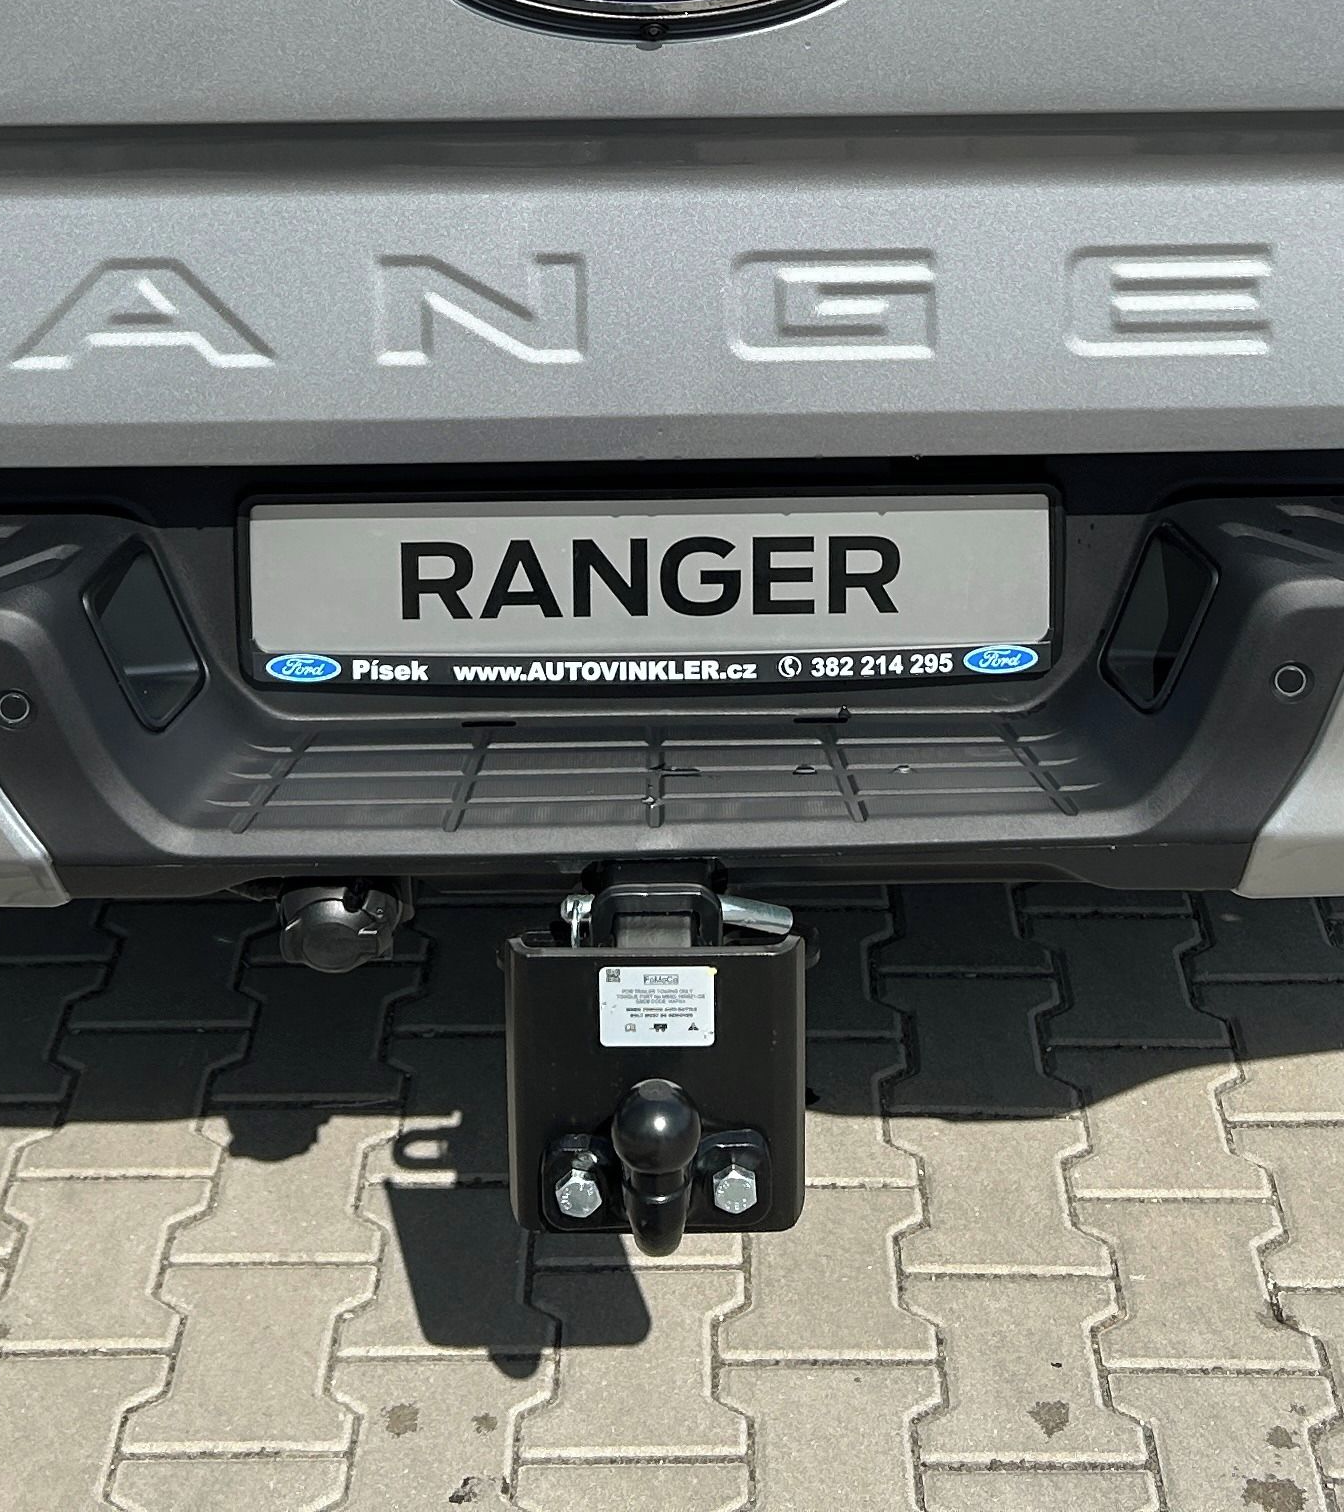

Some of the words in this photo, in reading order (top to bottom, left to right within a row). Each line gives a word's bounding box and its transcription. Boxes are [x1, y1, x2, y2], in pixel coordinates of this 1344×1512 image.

[399, 535, 903, 621] RANGER
[352, 658, 429, 682] Písek
[453, 659, 758, 683] www.AUTOVINKLER.cz
[810, 656, 854, 678] 382
[860, 654, 904, 677] 214
[910, 652, 954, 674] 295
